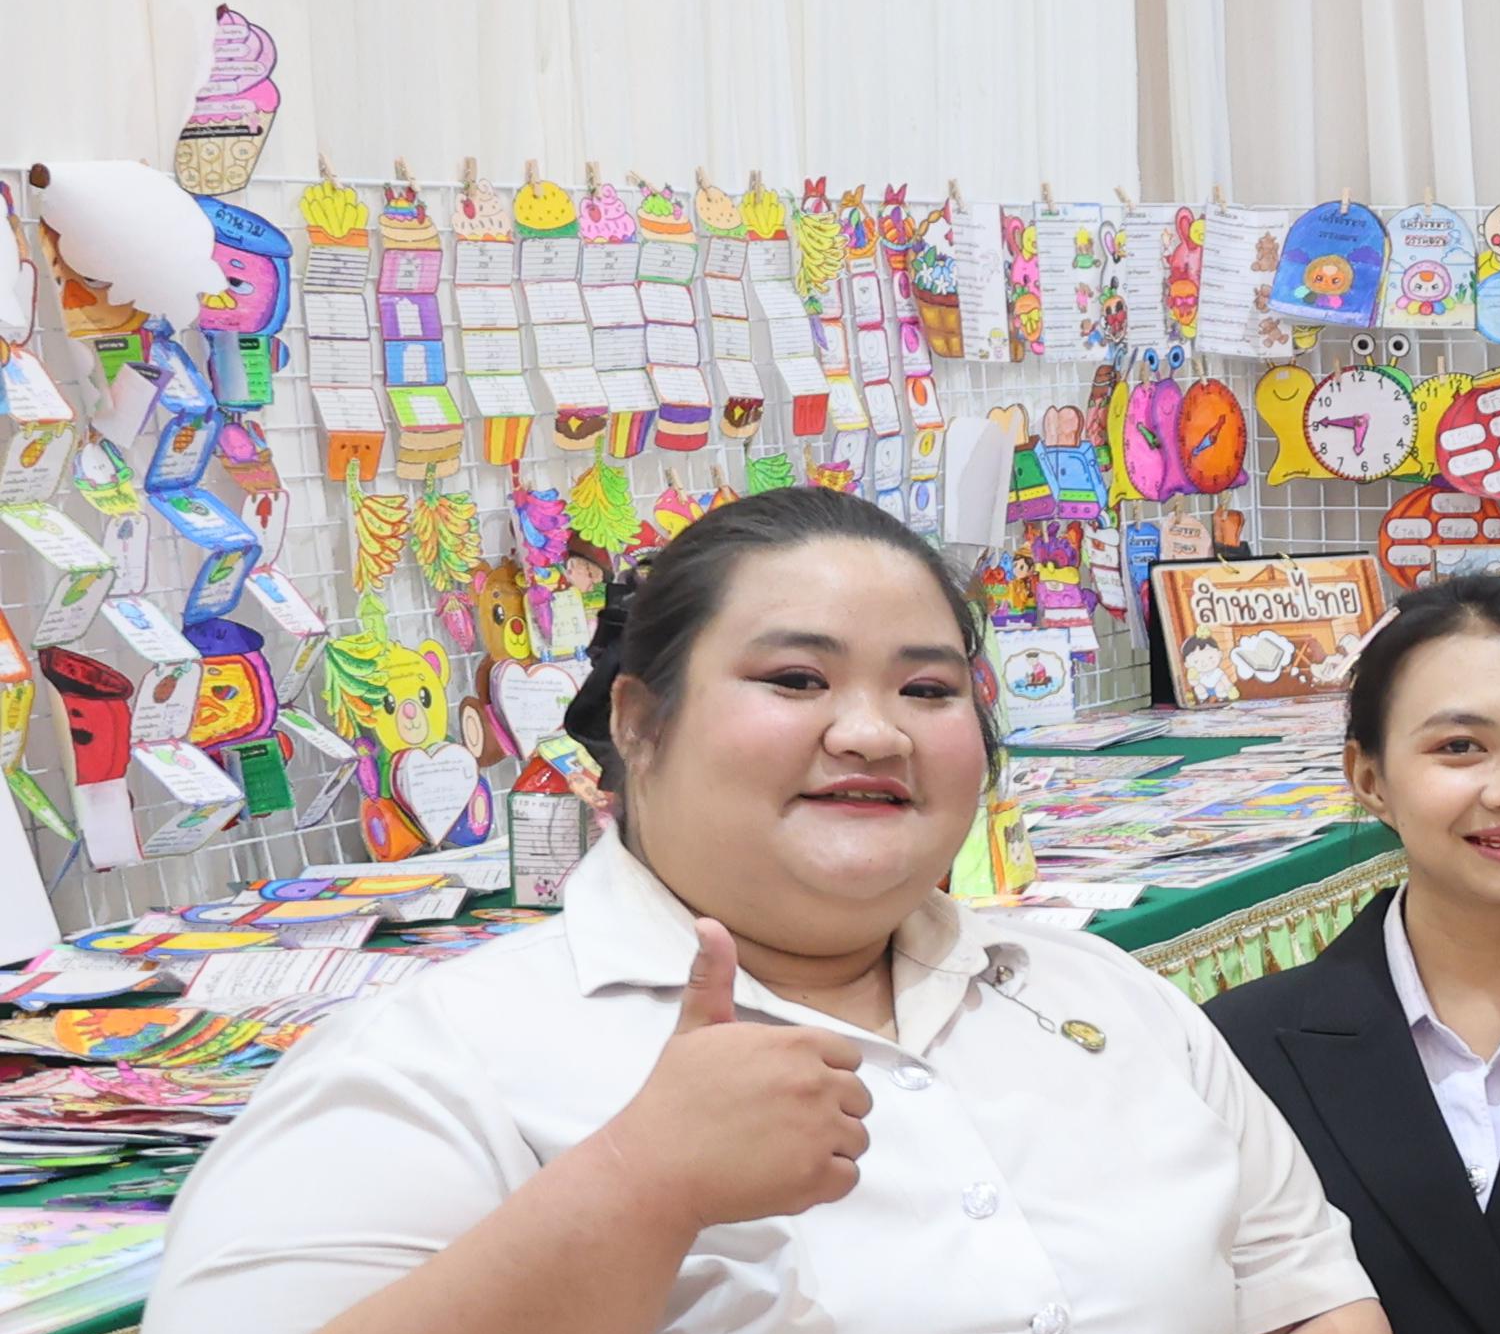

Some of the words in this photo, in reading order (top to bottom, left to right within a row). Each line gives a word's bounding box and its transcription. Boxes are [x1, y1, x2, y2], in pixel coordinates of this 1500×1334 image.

[1351, 370, 1366, 383] 12
[1329, 381, 1343, 393] 11
[1378, 378, 1384, 390] 1
[1394, 389, 1402, 401] 2
[1425, 387, 1439, 399] 11
[1318, 396, 1333, 408] 10
[1402, 414, 1411, 425] 3
[1311, 420, 1320, 432] 9
[1319, 442, 1329, 455] 8
[1396, 438, 1405, 449] 4
[1336, 456, 1345, 469] 7
[1382, 453, 1391, 465] 5
[1360, 461, 1369, 473] 6
[1195, 570, 1359, 624] สำนวนไทย
